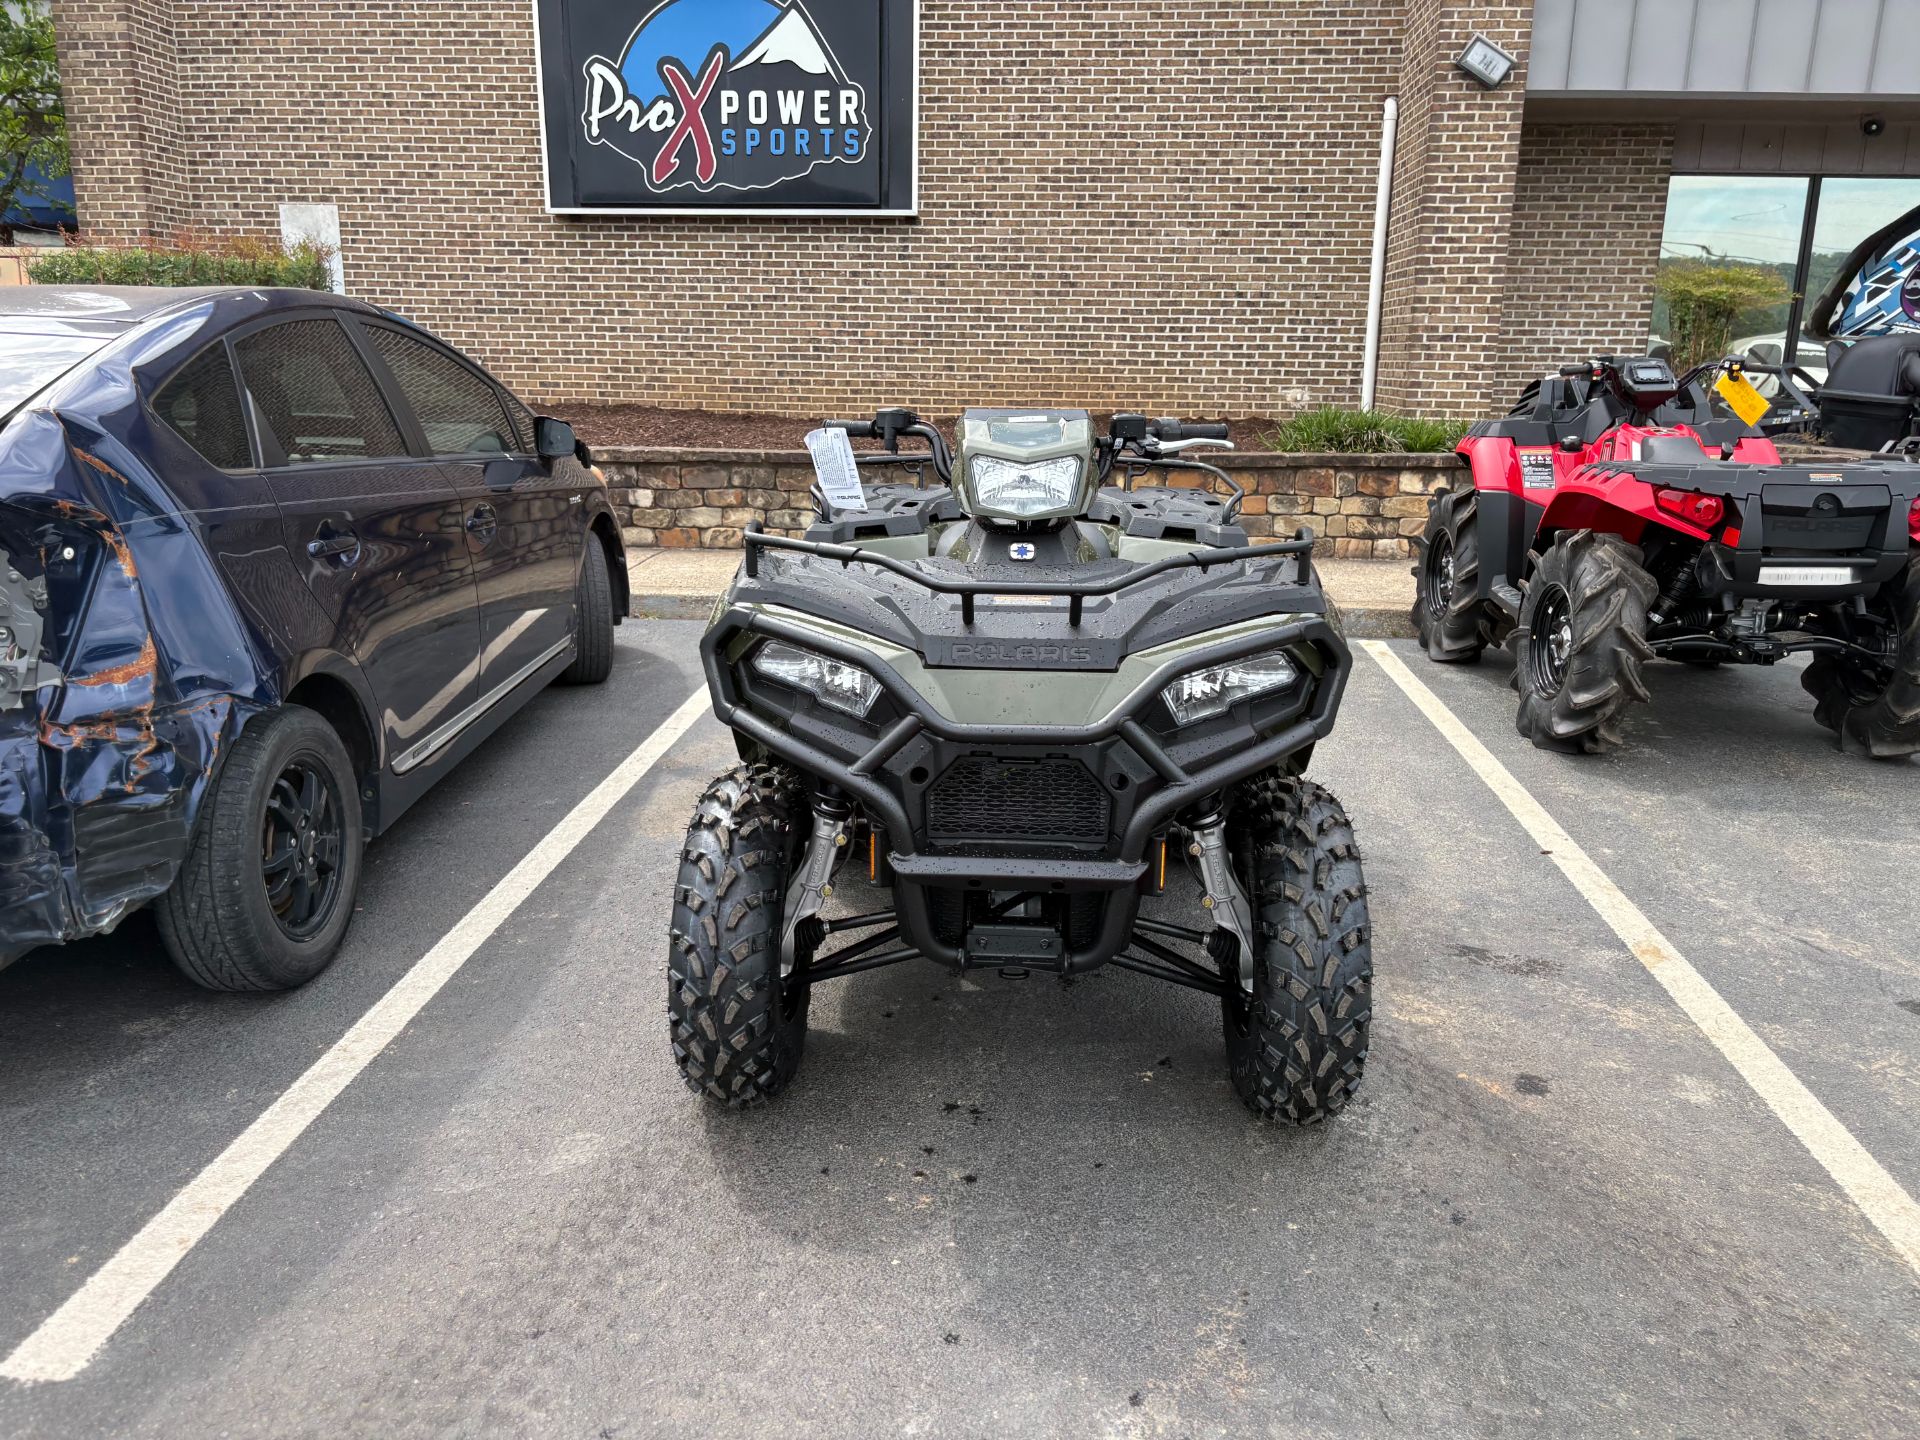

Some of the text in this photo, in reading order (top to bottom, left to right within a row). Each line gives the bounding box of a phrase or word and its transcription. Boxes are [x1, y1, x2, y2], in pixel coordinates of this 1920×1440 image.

[720, 89, 859, 125] POWER
[720, 128, 860, 156] SPORTS
[951, 643, 1091, 662] POLARIS
